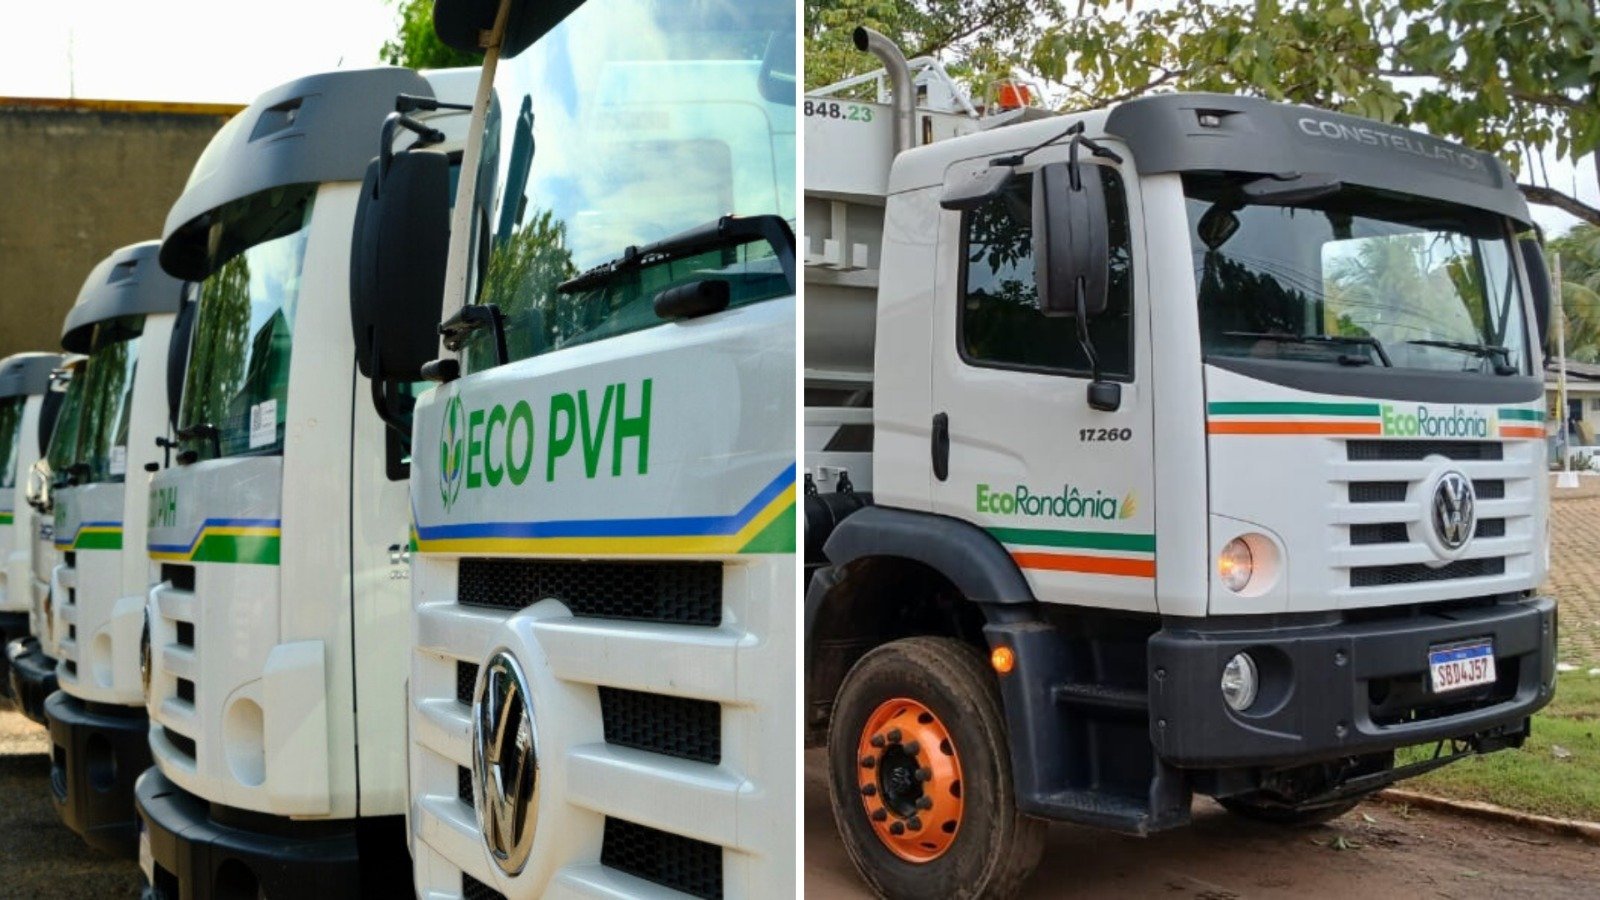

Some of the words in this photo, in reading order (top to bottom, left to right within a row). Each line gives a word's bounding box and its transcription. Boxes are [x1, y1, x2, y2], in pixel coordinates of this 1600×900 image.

[804, 100, 872, 122] 848.23
[466, 400, 533, 489] ECO
[547, 378, 652, 482] PVH
[1079, 428, 1132, 441] 17.260
[1382, 405, 1487, 437] EcoRondônia
[976, 483, 1117, 519] EcoRondônia
